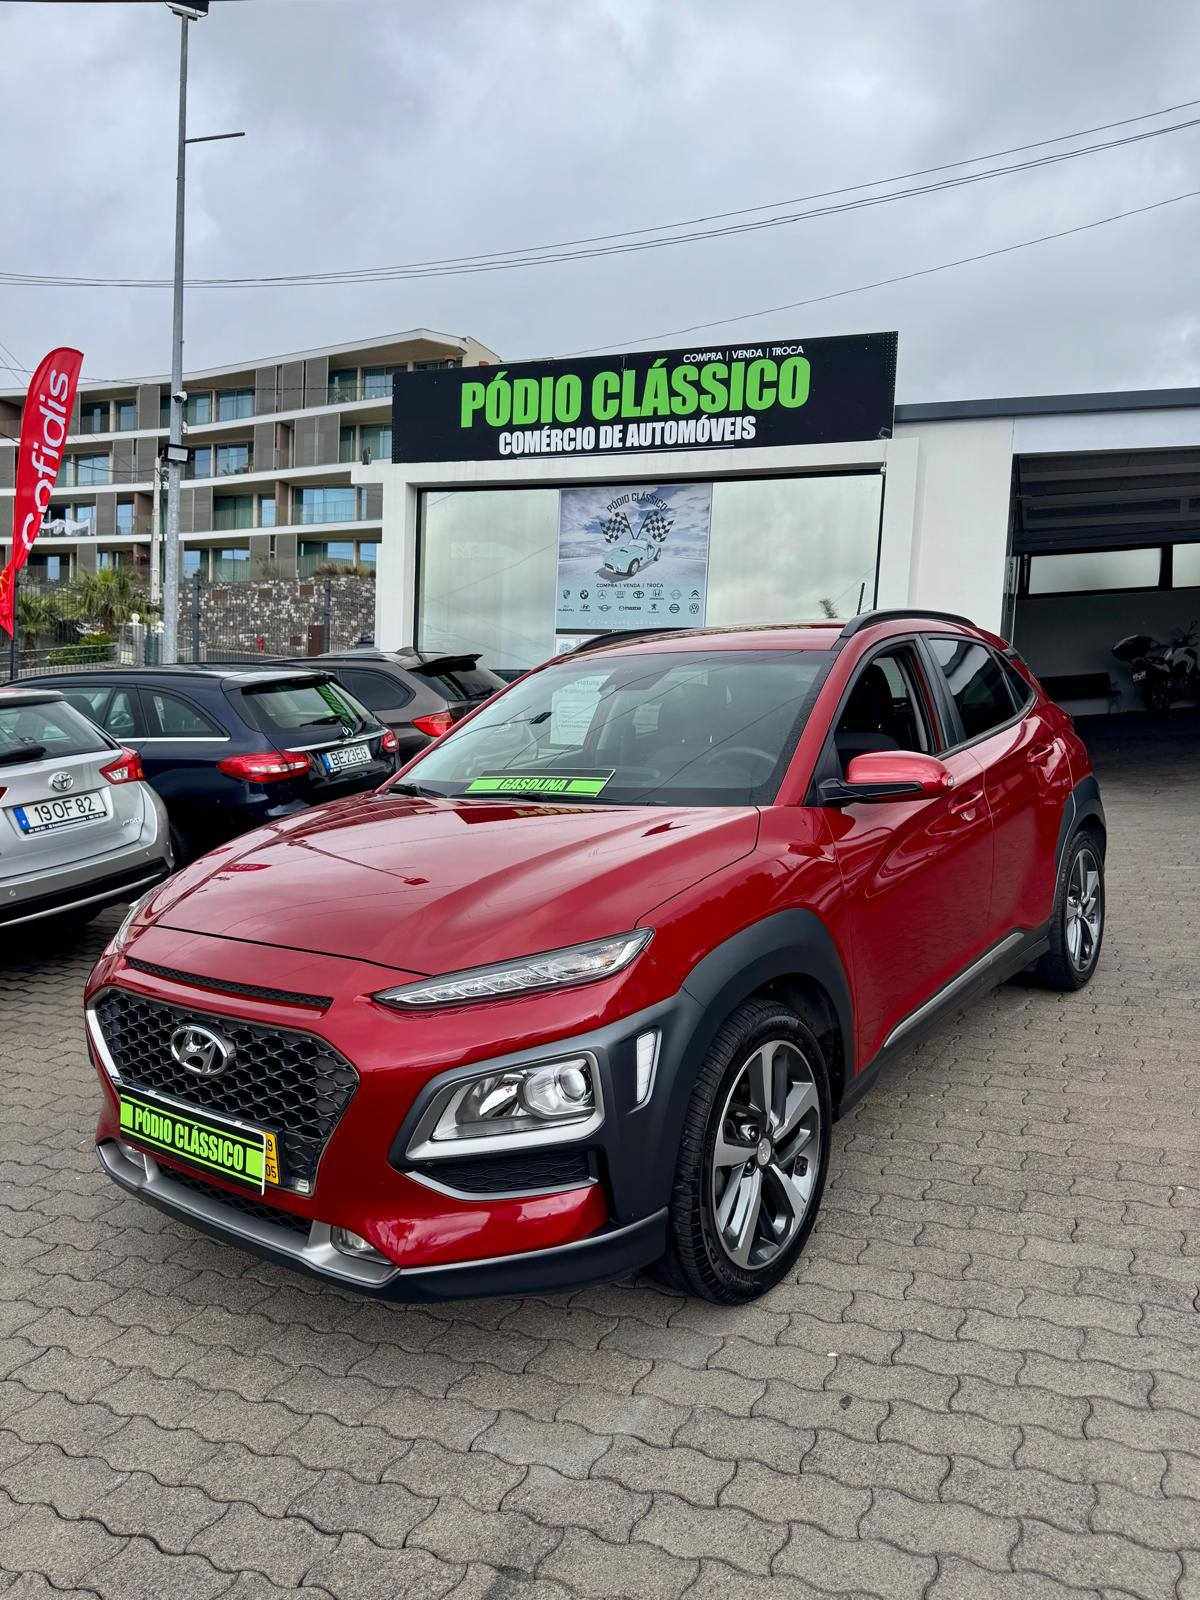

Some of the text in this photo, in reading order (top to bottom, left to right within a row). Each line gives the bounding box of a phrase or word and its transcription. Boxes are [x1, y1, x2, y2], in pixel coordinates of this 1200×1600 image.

[683, 345, 804, 363] COMPRA VENDA TROCA
[461, 356, 811, 428] PÓDIO CLÁSSICO
[499, 414, 757, 455] COMÉRCIO DE AUTOMÓVEIS
[606, 490, 669, 514] PÓDIO CLÁSSICO
[499, 778, 568, 791] GASOLINA
[34, 805, 52, 823] 19
[53, 799, 73, 819] OF
[75, 796, 96, 814] 82
[134, 1103, 244, 1171] PÓDIO CLÁSSICO
